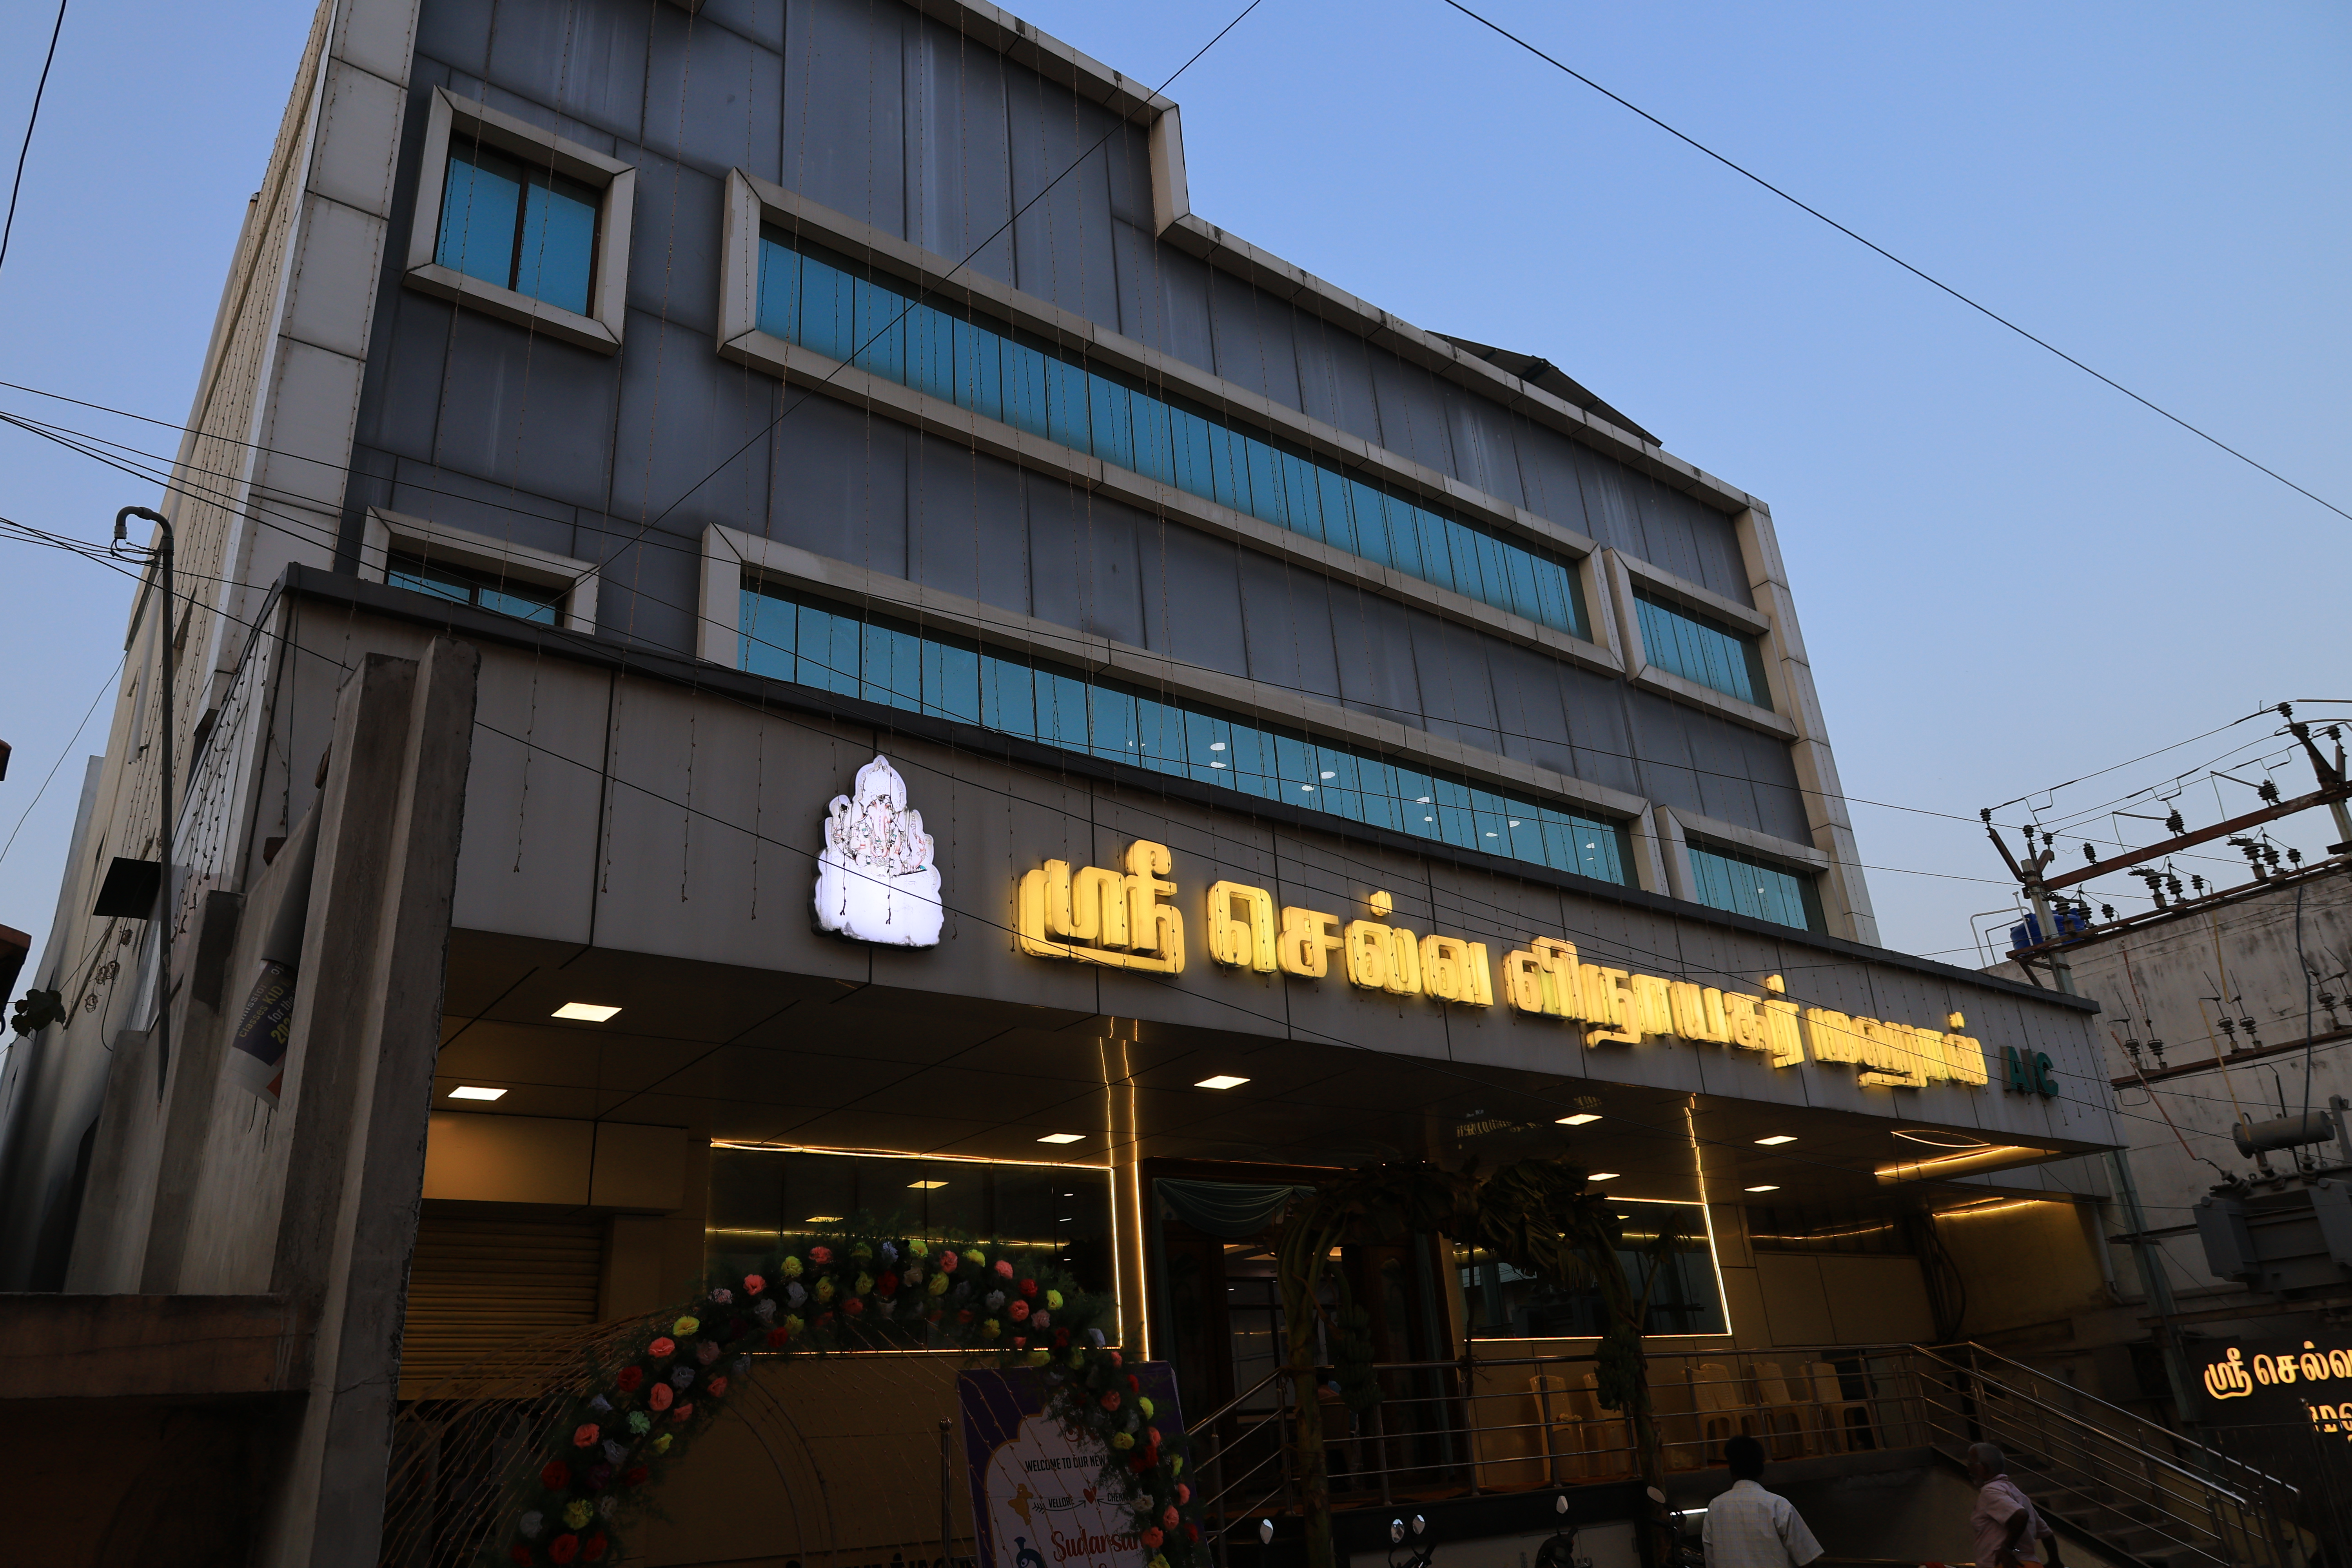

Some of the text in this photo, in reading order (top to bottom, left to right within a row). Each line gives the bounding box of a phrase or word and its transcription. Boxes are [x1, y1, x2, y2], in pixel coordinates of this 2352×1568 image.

[1207, 880, 1494, 1008] செல்வ
[1503, 936, 1806, 1069] விநாயகர்
[1806, 1007, 1989, 1089] மஹால்
[239, 1005, 268, 1038] Classes
[261, 985, 284, 1005] KID
[267, 996, 295, 1023] for the
[1025, 1454, 1105, 1472] WELCOME TO OUR NEW
